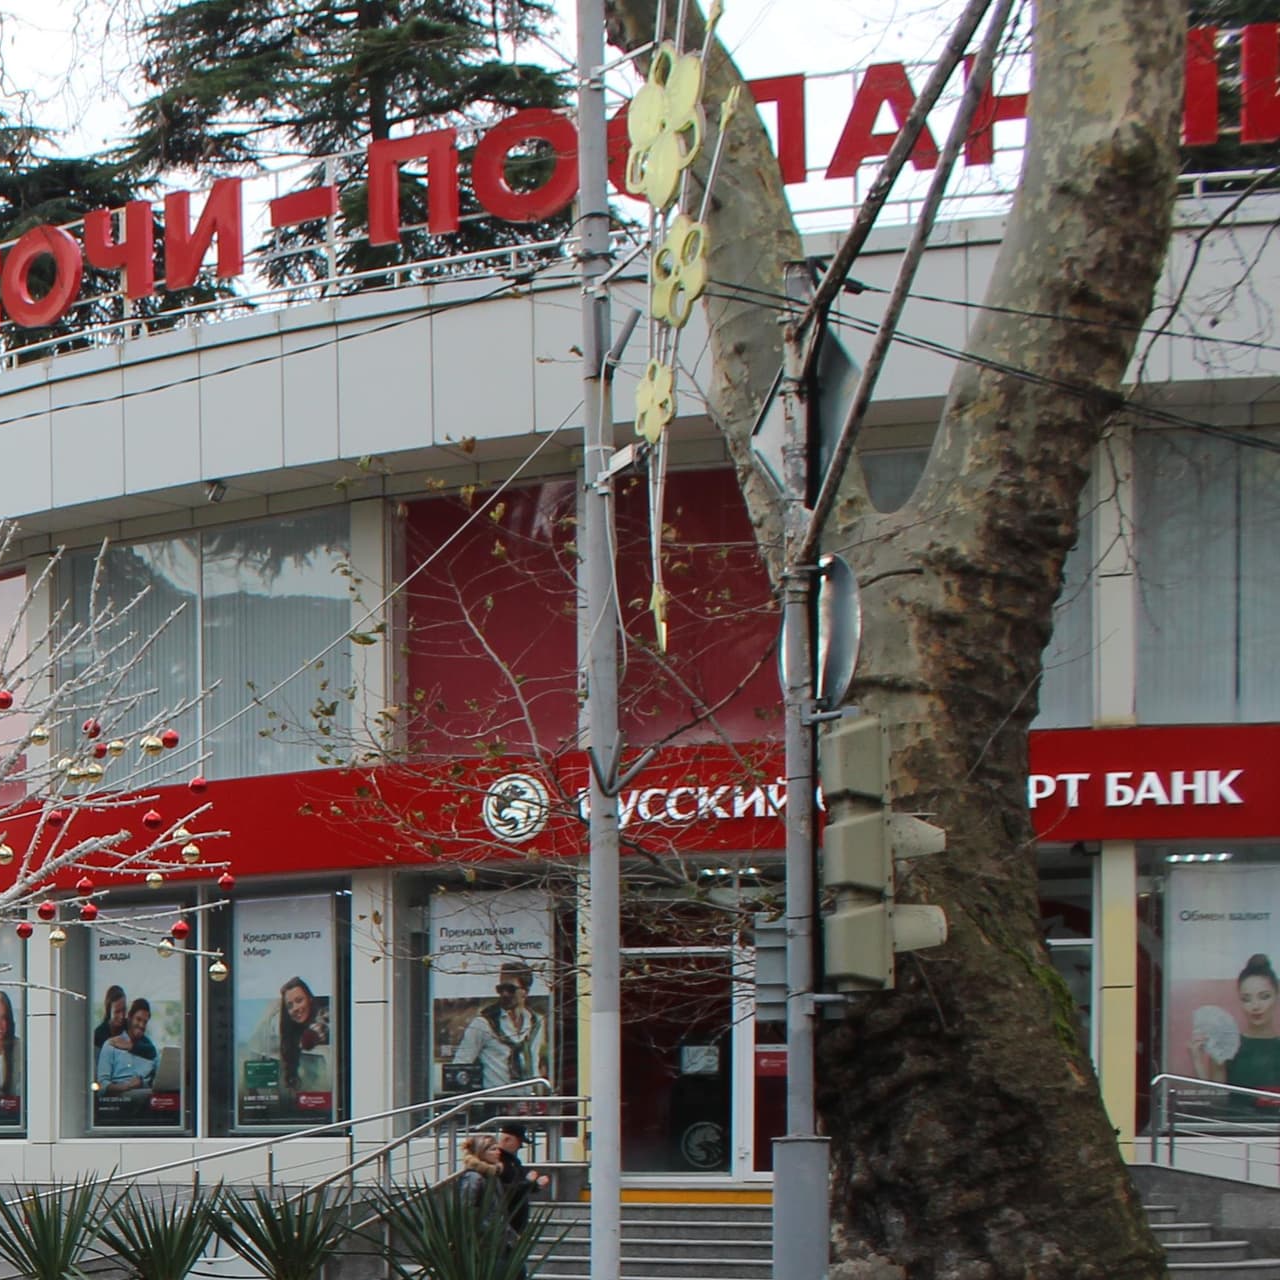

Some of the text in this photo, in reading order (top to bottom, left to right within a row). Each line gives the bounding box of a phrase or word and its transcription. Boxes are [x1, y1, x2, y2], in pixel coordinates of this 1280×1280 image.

[1105, 769, 1244, 808] БАНК
[1179, 910, 1272, 921] Обмен валют
[243, 930, 321, 943] Кредитная карта
